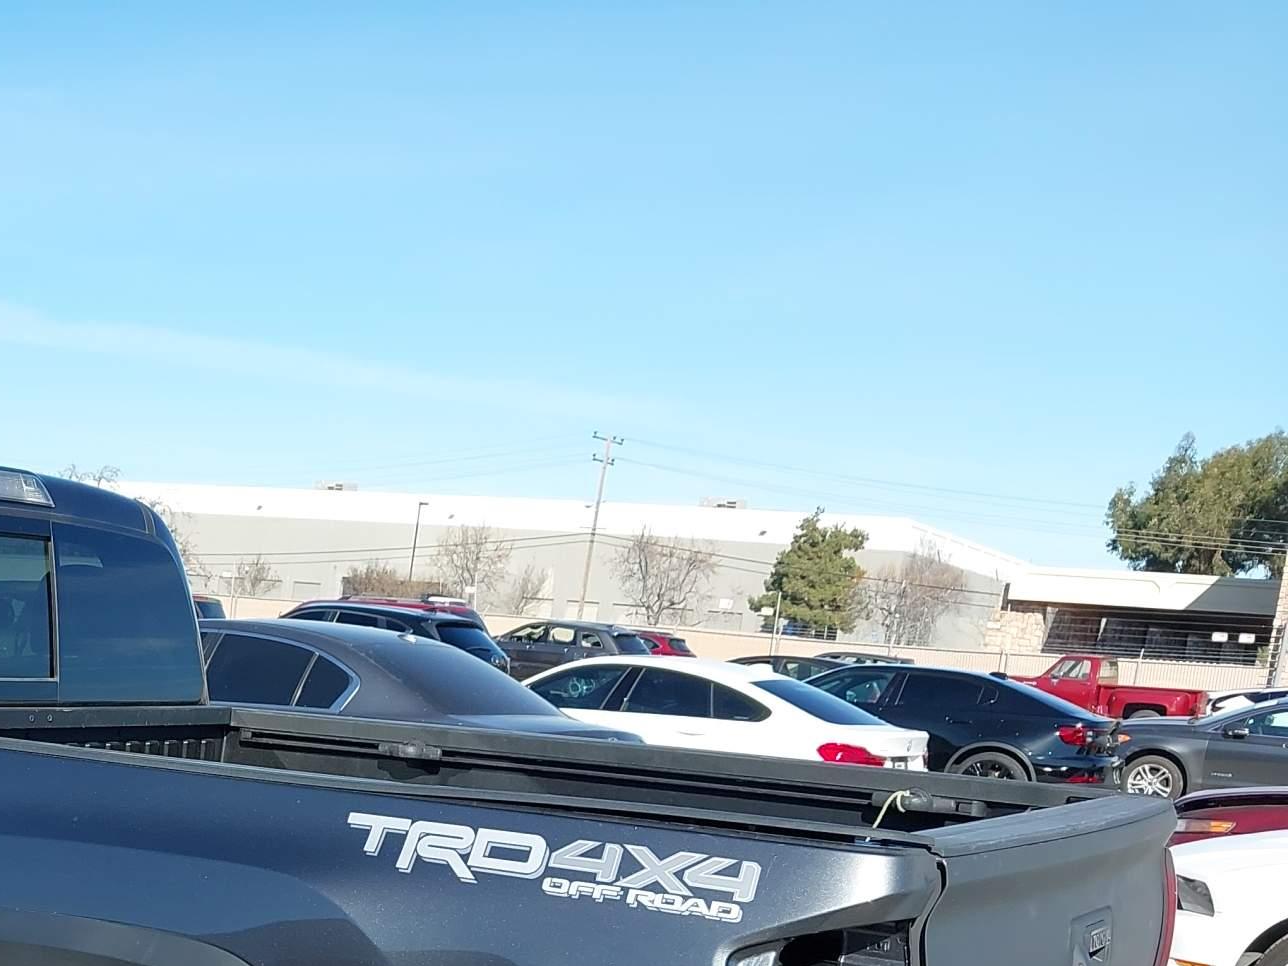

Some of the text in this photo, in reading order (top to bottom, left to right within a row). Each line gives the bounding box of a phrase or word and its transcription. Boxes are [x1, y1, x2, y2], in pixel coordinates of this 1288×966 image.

[347, 812, 550, 884] TRD
[542, 876, 743, 924] OFF ROAD
